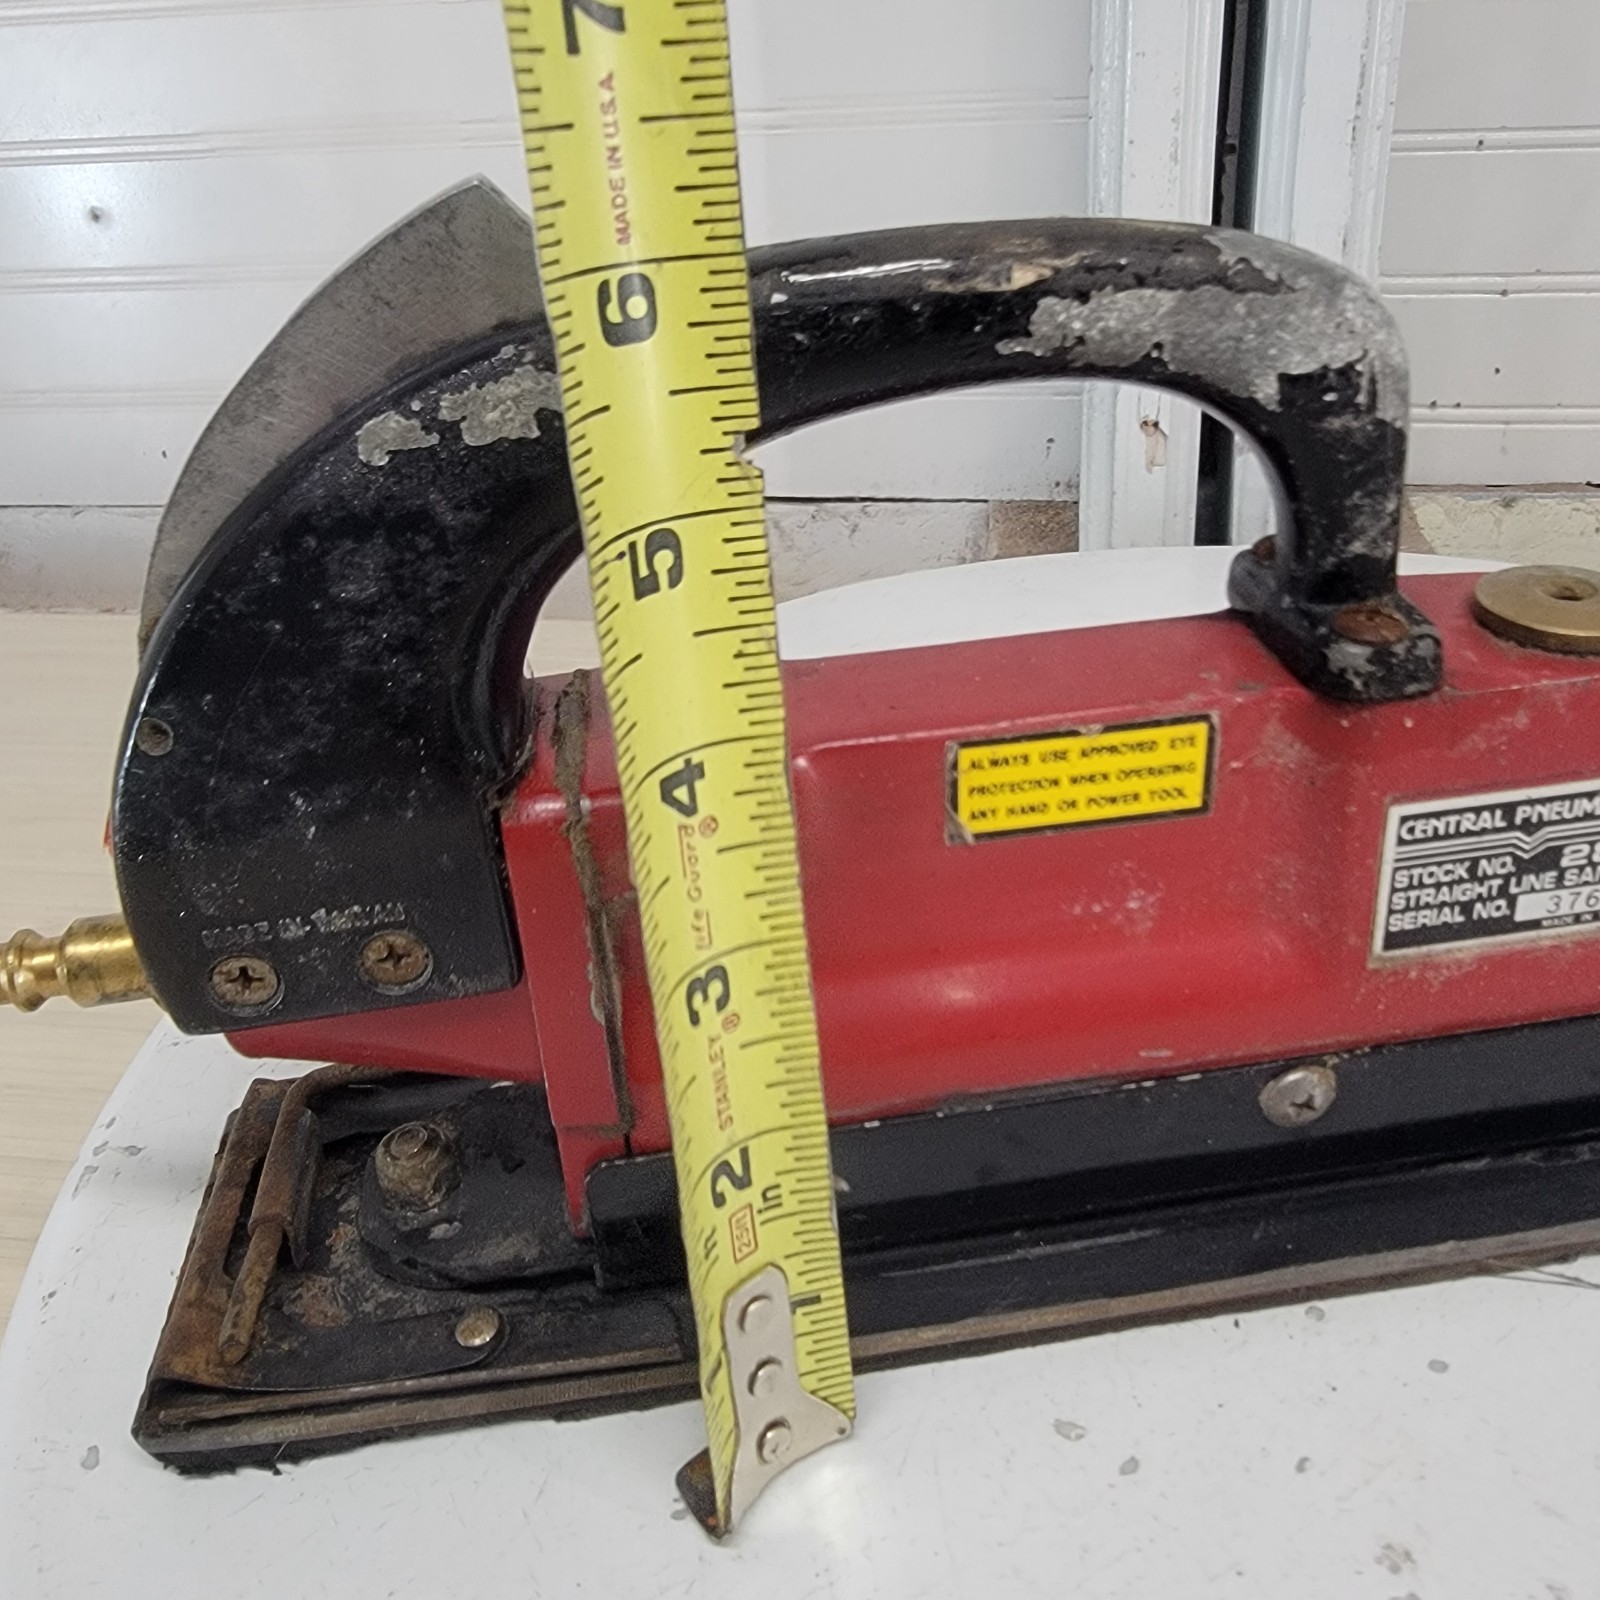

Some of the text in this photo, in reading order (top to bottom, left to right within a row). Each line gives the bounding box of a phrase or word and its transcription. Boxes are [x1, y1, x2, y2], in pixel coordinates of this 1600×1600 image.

[561, 0, 626, 55] 7
[606, 145, 624, 170] IN
[609, 176, 631, 245] MADE
[597, 272, 657, 347] 6
[628, 528, 684, 601] 5
[660, 758, 705, 817] 4
[1400, 809, 1507, 840] CENTRAL
[1391, 879, 1503, 911] STRAIGHT
[1508, 870, 1558, 894] LINE
[1393, 860, 1471, 889] STOCK
[1477, 855, 1516, 877] NO.
[1388, 905, 1465, 932] SERIAL
[1472, 899, 1510, 920] NO.
[686, 965, 731, 1027] 3
[711, 1146, 752, 1208] 2
[757, 1184, 783, 1214] in
